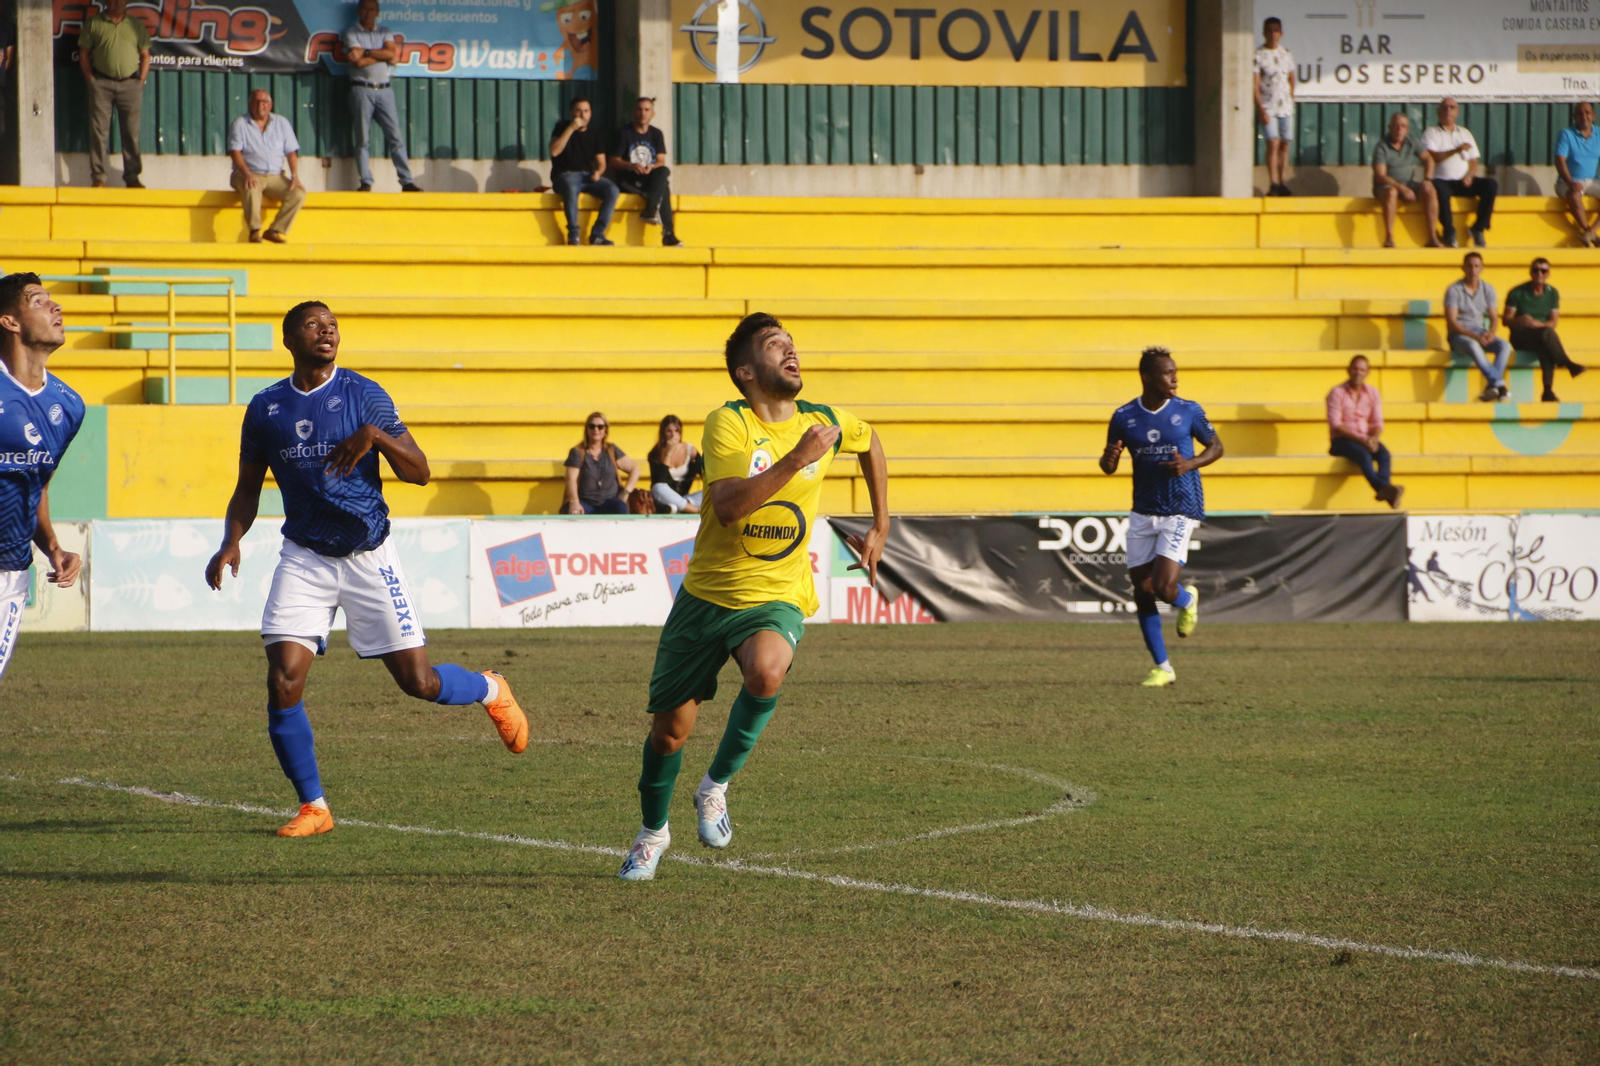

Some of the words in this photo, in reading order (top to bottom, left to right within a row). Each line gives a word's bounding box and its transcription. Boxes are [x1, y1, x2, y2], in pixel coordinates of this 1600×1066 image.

[427, 10, 498, 23] descuentos
[1502, 17, 1541, 31] COMIDA
[1545, 17, 1586, 31] CASERA
[800, 7, 1158, 62] SOTOVILA
[1341, 35, 1392, 55] BAR
[178, 56, 202, 69] para
[203, 54, 244, 67] clientes
[459, 40, 535, 70] Wash
[1297, 58, 1322, 84] UÍ
[1335, 64, 1369, 84] OS
[742, 523, 797, 540] ACERINOX
[1419, 520, 1487, 543] Mesón
[1478, 560, 1598, 602] COPO
[378, 565, 413, 623] XEREZ
[518, 606, 543, 627] Todo
[545, 599, 573, 620] para
[574, 592, 590, 602] su
[593, 581, 637, 605] Oficina
